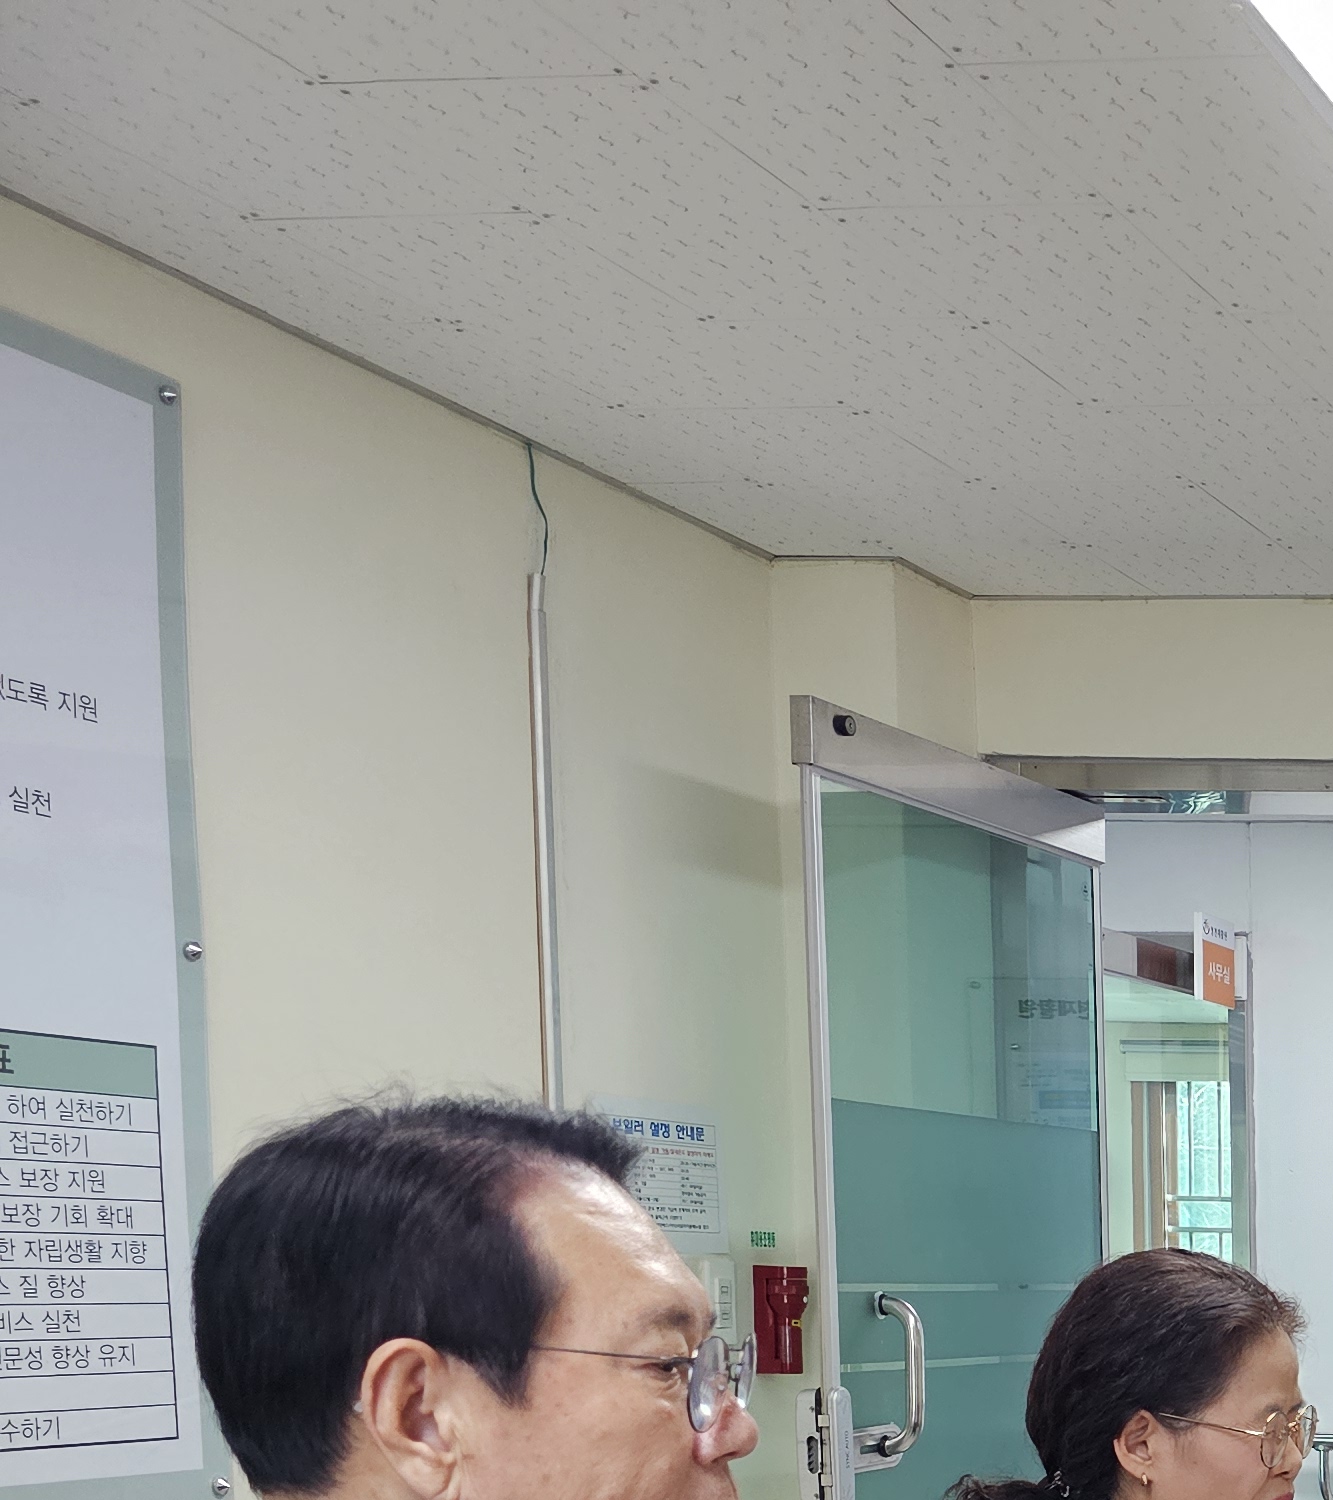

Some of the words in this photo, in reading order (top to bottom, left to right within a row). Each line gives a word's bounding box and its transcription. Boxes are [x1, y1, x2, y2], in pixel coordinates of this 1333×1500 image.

[0, 674, 49, 711] 도록
[58, 691, 98, 723] 지원
[8, 786, 52, 818] 실천
[1208, 961, 1231, 985] 사무실
[7, 1094, 46, 1120] 하여
[55, 1098, 132, 1126] 실천하기
[9, 1131, 89, 1158] 접근하기
[650, 1121, 671, 1139] 설정
[676, 1124, 705, 1142] 안내문
[19, 1168, 60, 1192] 보장
[68, 1169, 105, 1193] 지원
[1, 1202, 42, 1227] 보장
[51, 1204, 88, 1228] 기회
[97, 1205, 133, 1229] 확대
[0, 1238, 16, 1261] 한
[24, 1239, 103, 1263] 자립생활
[111, 1240, 147, 1264] 지향
[19, 1274, 38, 1298] 질
[47, 1274, 86, 1298] 향상
[0, 1310, 34, 1334] 비스
[42, 1309, 81, 1333] 실천
[0, 1346, 43, 1370] 문성
[51, 1345, 90, 1369] 향상
[98, 1343, 136, 1368] 유지
[1, 1416, 60, 1442] 수하기
